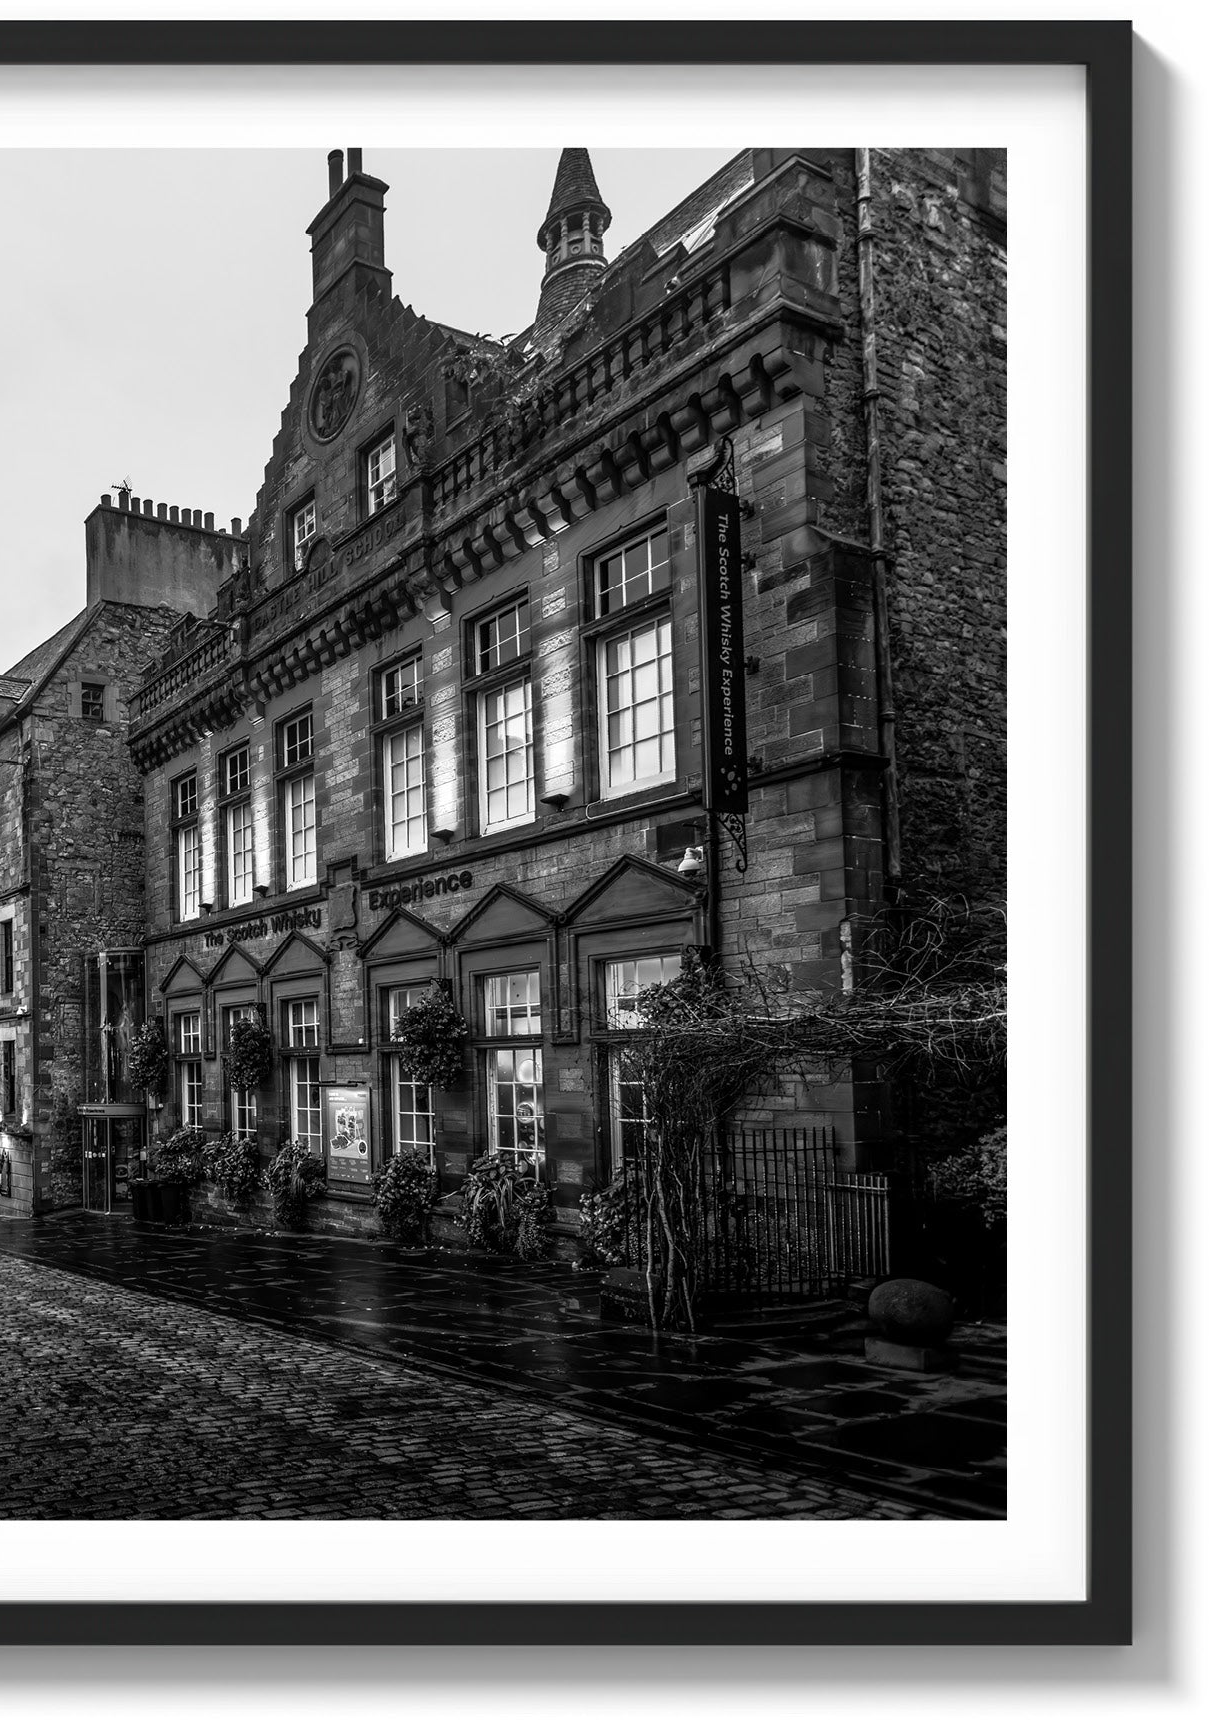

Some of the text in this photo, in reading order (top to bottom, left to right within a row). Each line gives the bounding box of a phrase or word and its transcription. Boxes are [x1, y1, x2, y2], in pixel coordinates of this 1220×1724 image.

[345, 512, 407, 568] SCHOOL
[718, 513, 734, 756] The Scotch Whisky Experience
[204, 870, 473, 948] The Scotch Whisky Experience
